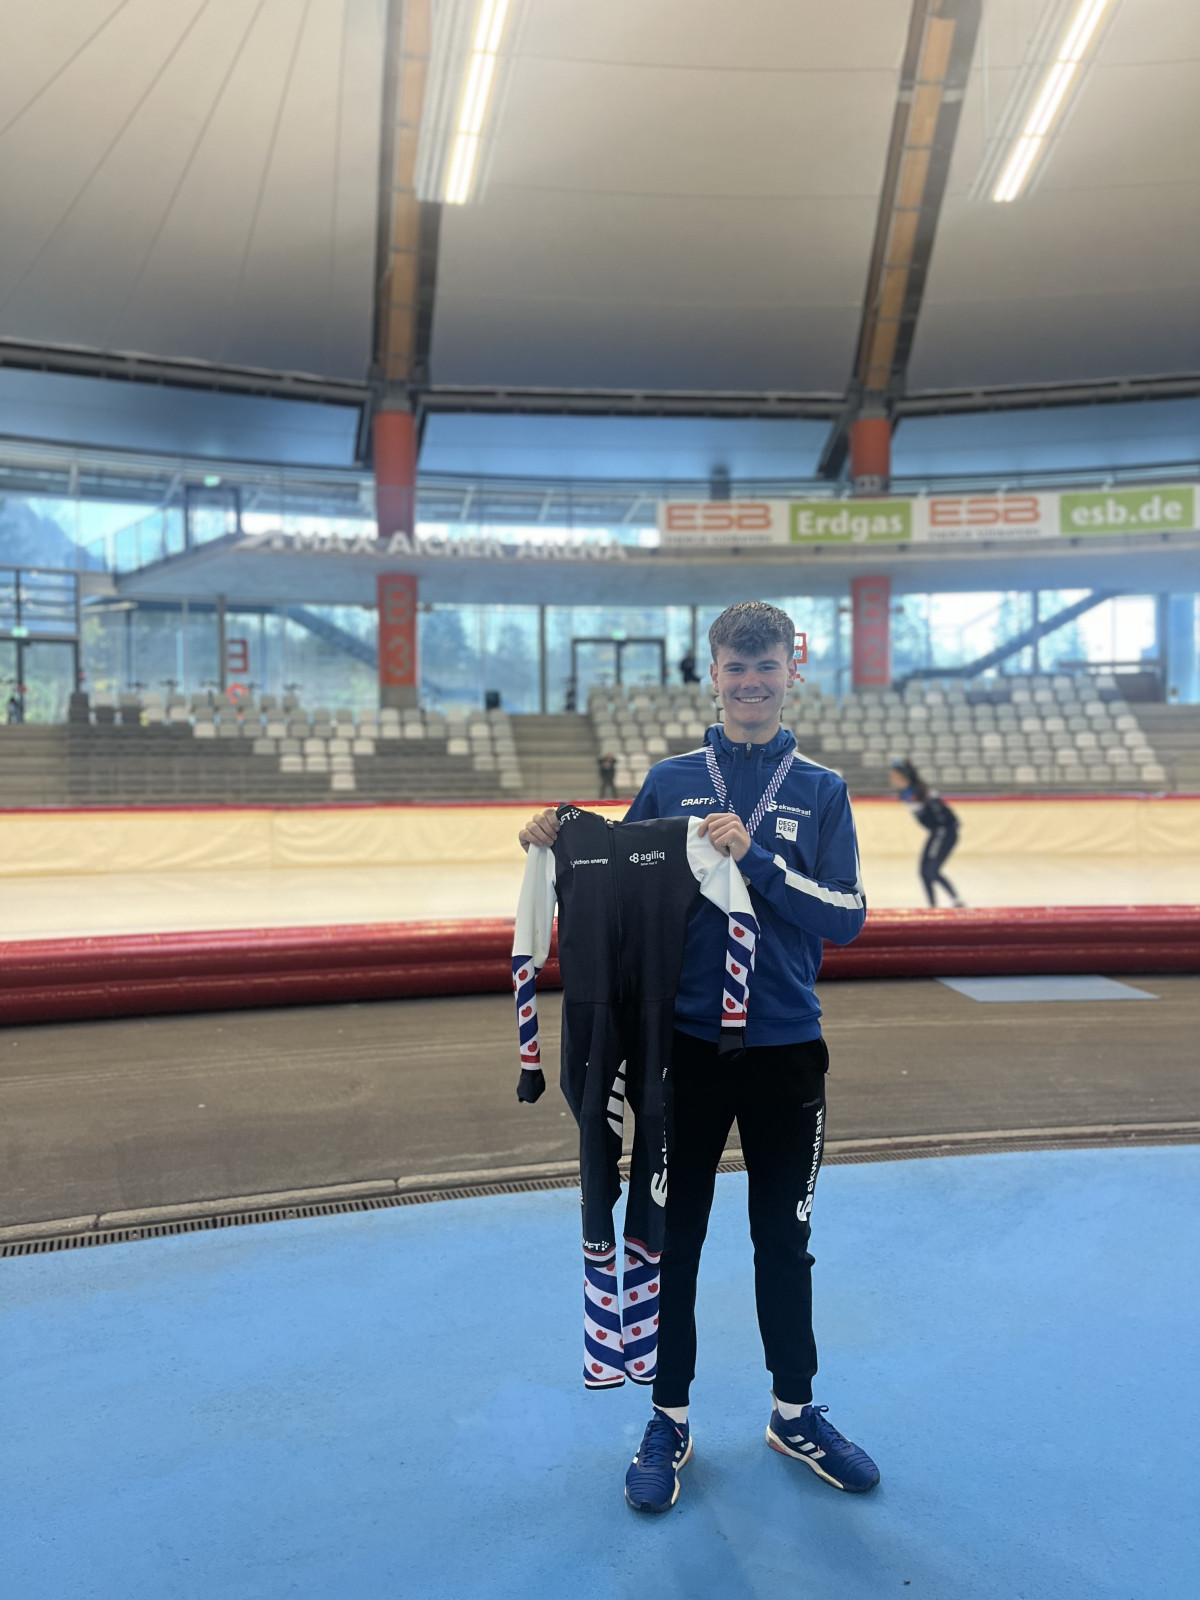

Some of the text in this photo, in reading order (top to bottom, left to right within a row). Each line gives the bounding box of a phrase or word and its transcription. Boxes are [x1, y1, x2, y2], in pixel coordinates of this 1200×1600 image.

[665, 503, 771, 531] ESB
[929, 496, 1040, 526] ESB
[1070, 494, 1183, 527] esb.de
[797, 509, 904, 542] Erdgas
[681, 797, 709, 807] CRAFT
[778, 803, 812, 816] ekwadraat
[778, 819, 797, 828] DECO
[640, 850, 665, 862] agiliq
[806, 1108, 823, 1192] ekwadraat
